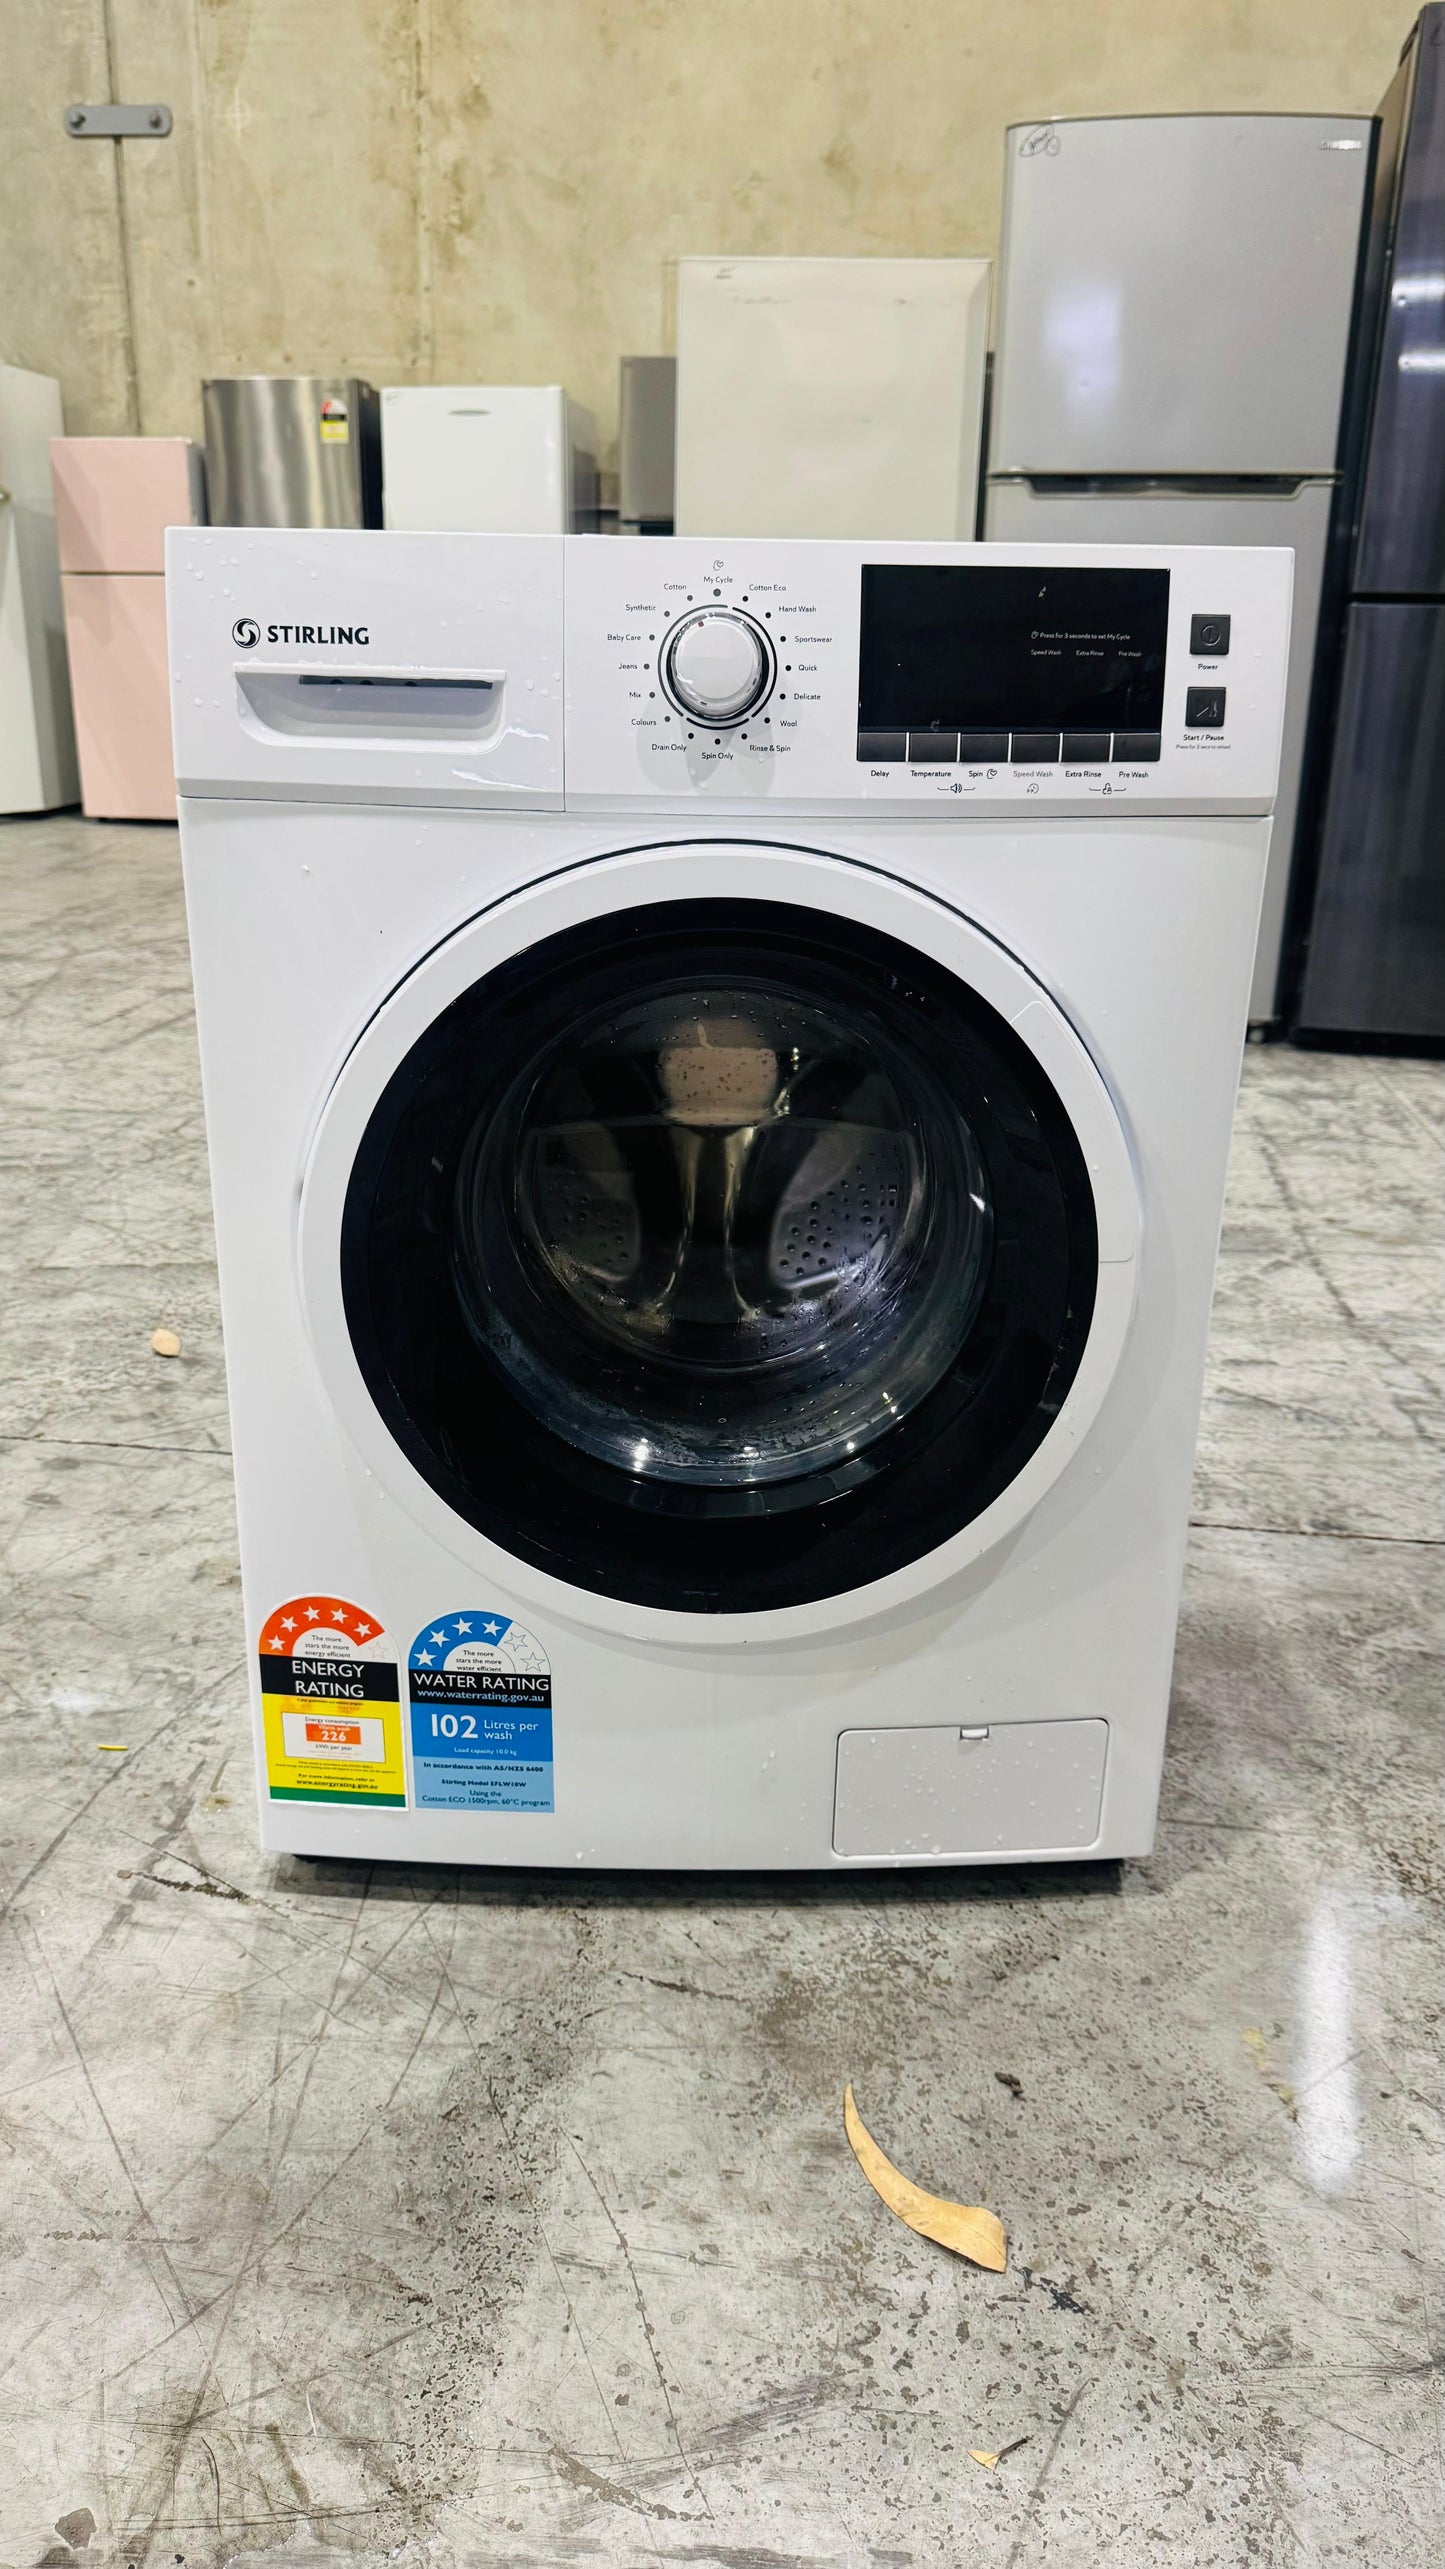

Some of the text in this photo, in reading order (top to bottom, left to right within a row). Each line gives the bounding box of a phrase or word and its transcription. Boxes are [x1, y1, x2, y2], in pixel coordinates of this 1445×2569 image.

[703, 576, 714, 584] My
[625, 604, 656, 612] Synthetic
[267, 625, 370, 645] STIRLING
[607, 634, 624, 642] Baby
[671, 744, 687, 752] Only
[776, 745, 791, 753] Spin
[702, 752, 717, 760] Spin
[911, 770, 951, 778] Temperature
[292, 1660, 364, 1678] ENERGY
[414, 1673, 549, 1691] WATER RATING
[295, 1680, 364, 1698] RATING
[417, 1690, 545, 1703] www.waterrating.gov.au
[431, 1713, 479, 1739] 102
[484, 1719, 539, 1732] Litres per
[321, 1731, 347, 1742] 226
[484, 1732, 512, 1740] wash
[422, 1795, 447, 1803] Cotton
